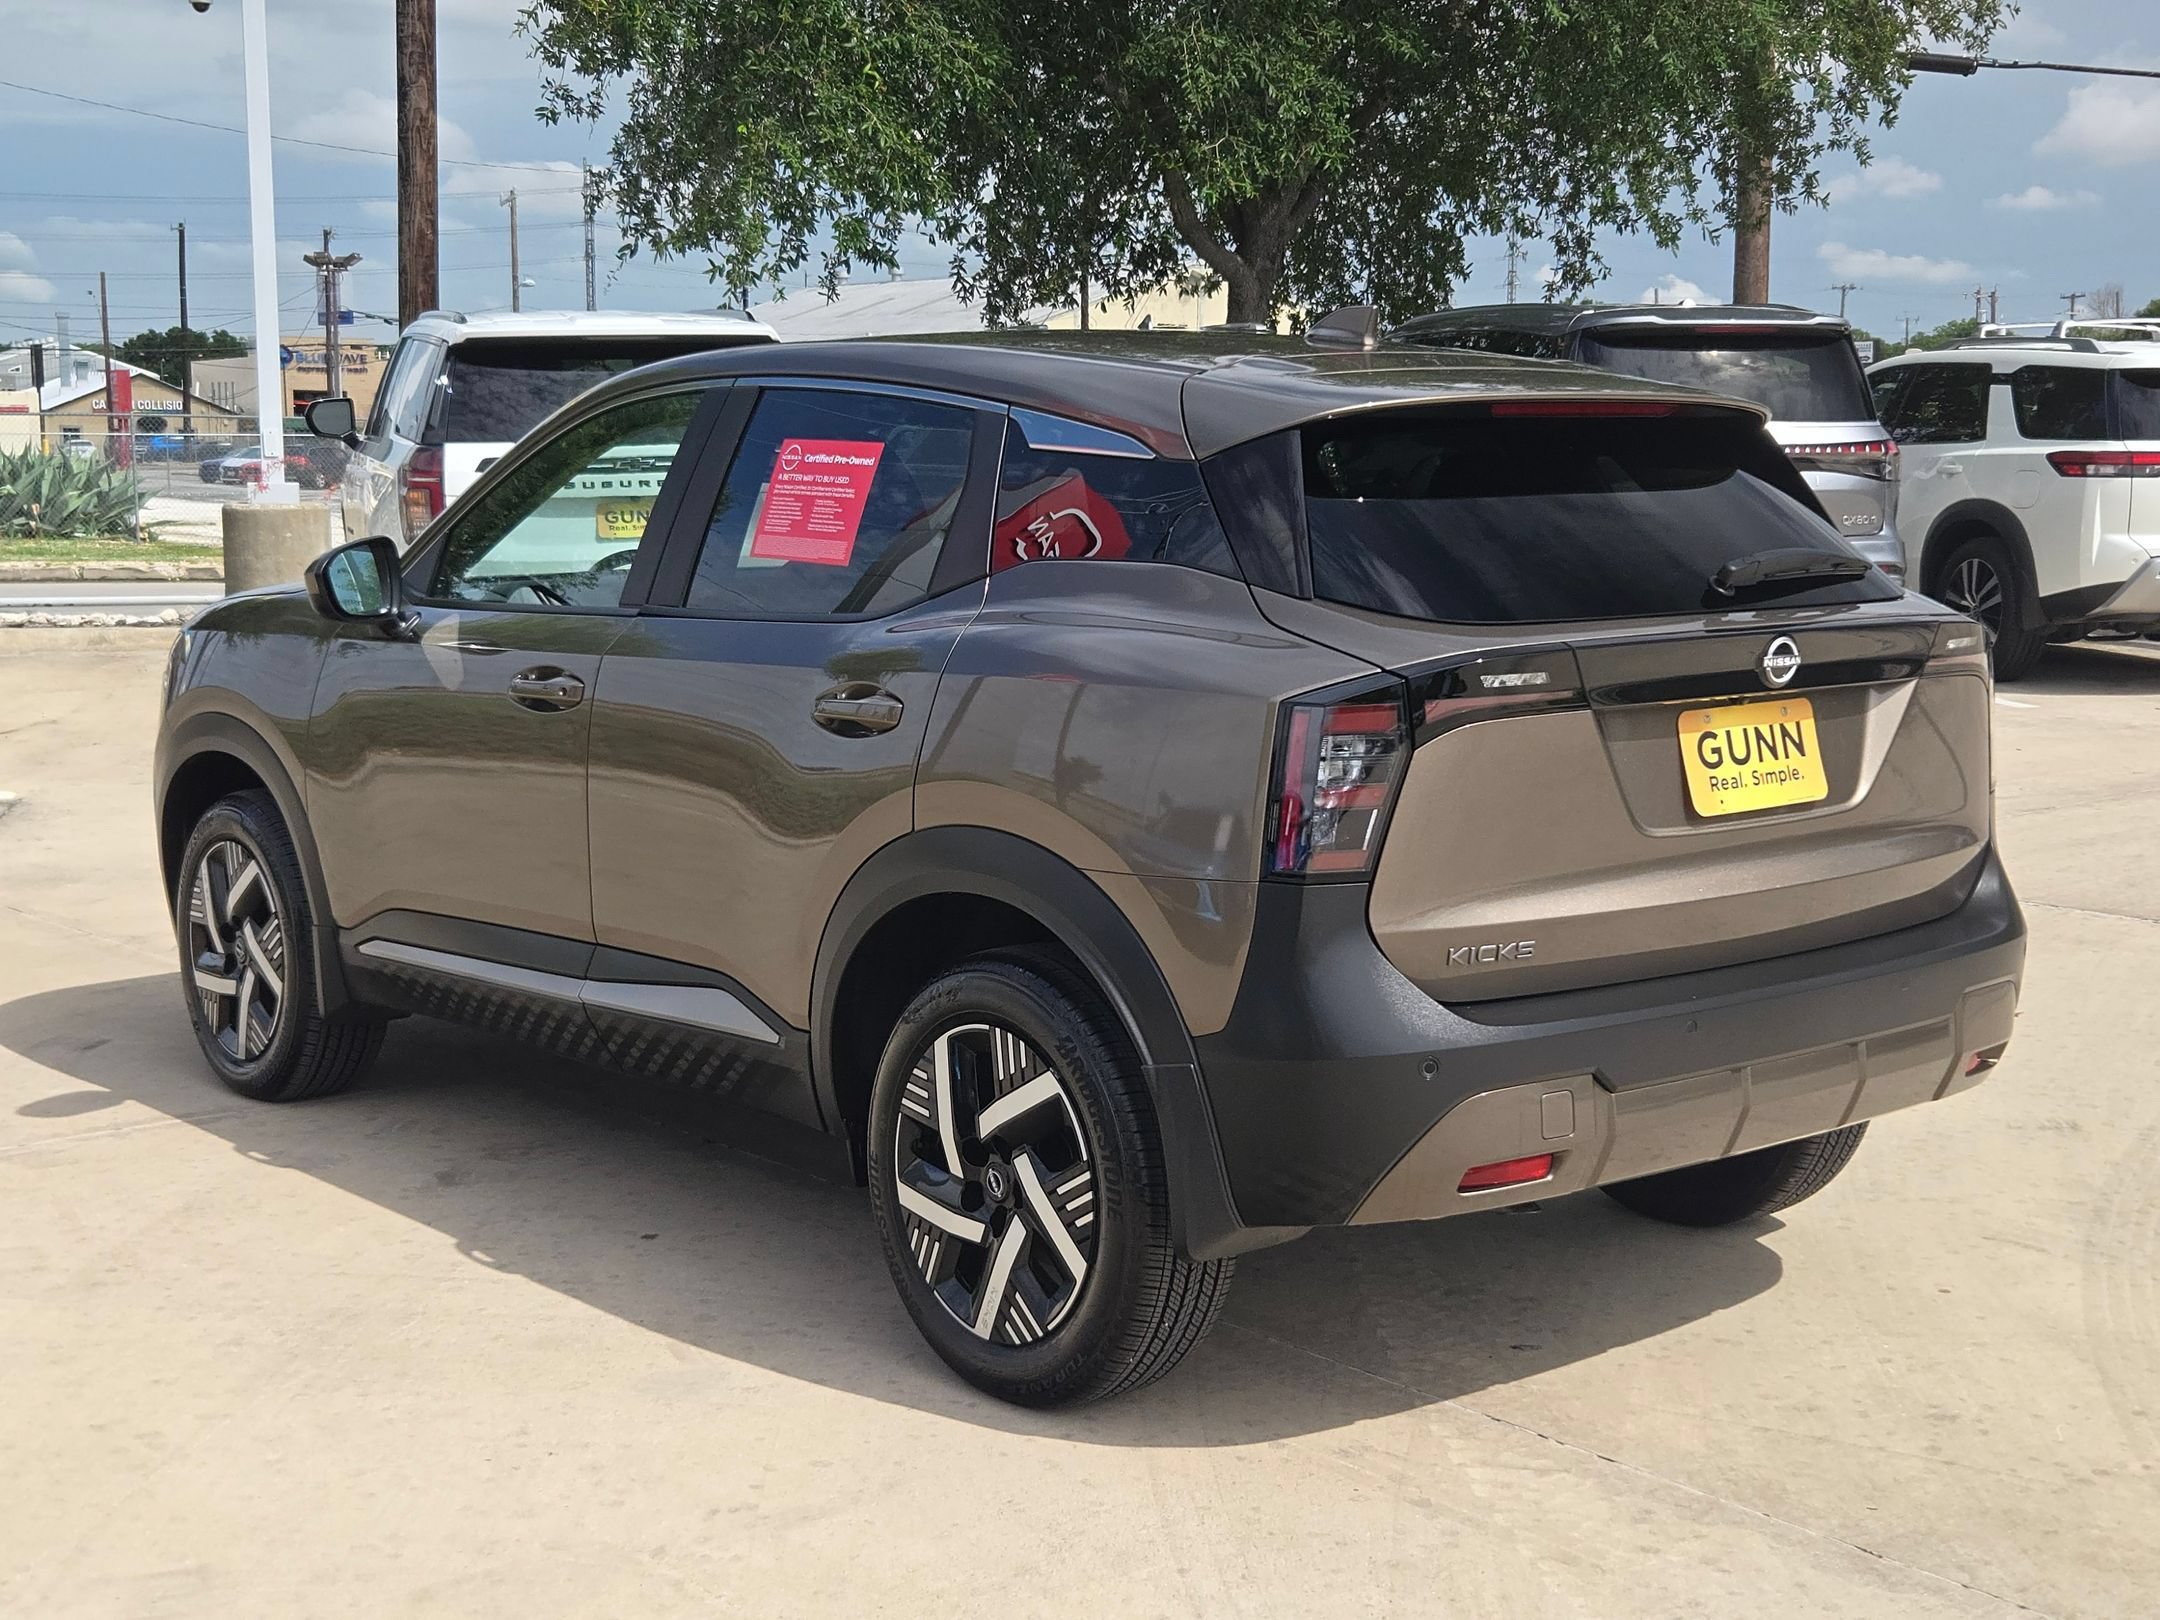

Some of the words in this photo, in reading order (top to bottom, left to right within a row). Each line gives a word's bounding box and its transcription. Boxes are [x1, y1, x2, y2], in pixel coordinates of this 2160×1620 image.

[137, 400, 184, 410] COLLISIO
[804, 453, 835, 464] Certified
[834, 455, 876, 466] Pre-Owned
[604, 510, 651, 524] GUN
[1763, 655, 1801, 668] NISSAN
[1697, 720, 1807, 770] GUNN
[1709, 771, 1749, 793] Real.
[1751, 765, 1805, 786] Simple.
[1446, 940, 1536, 967] KICKS
